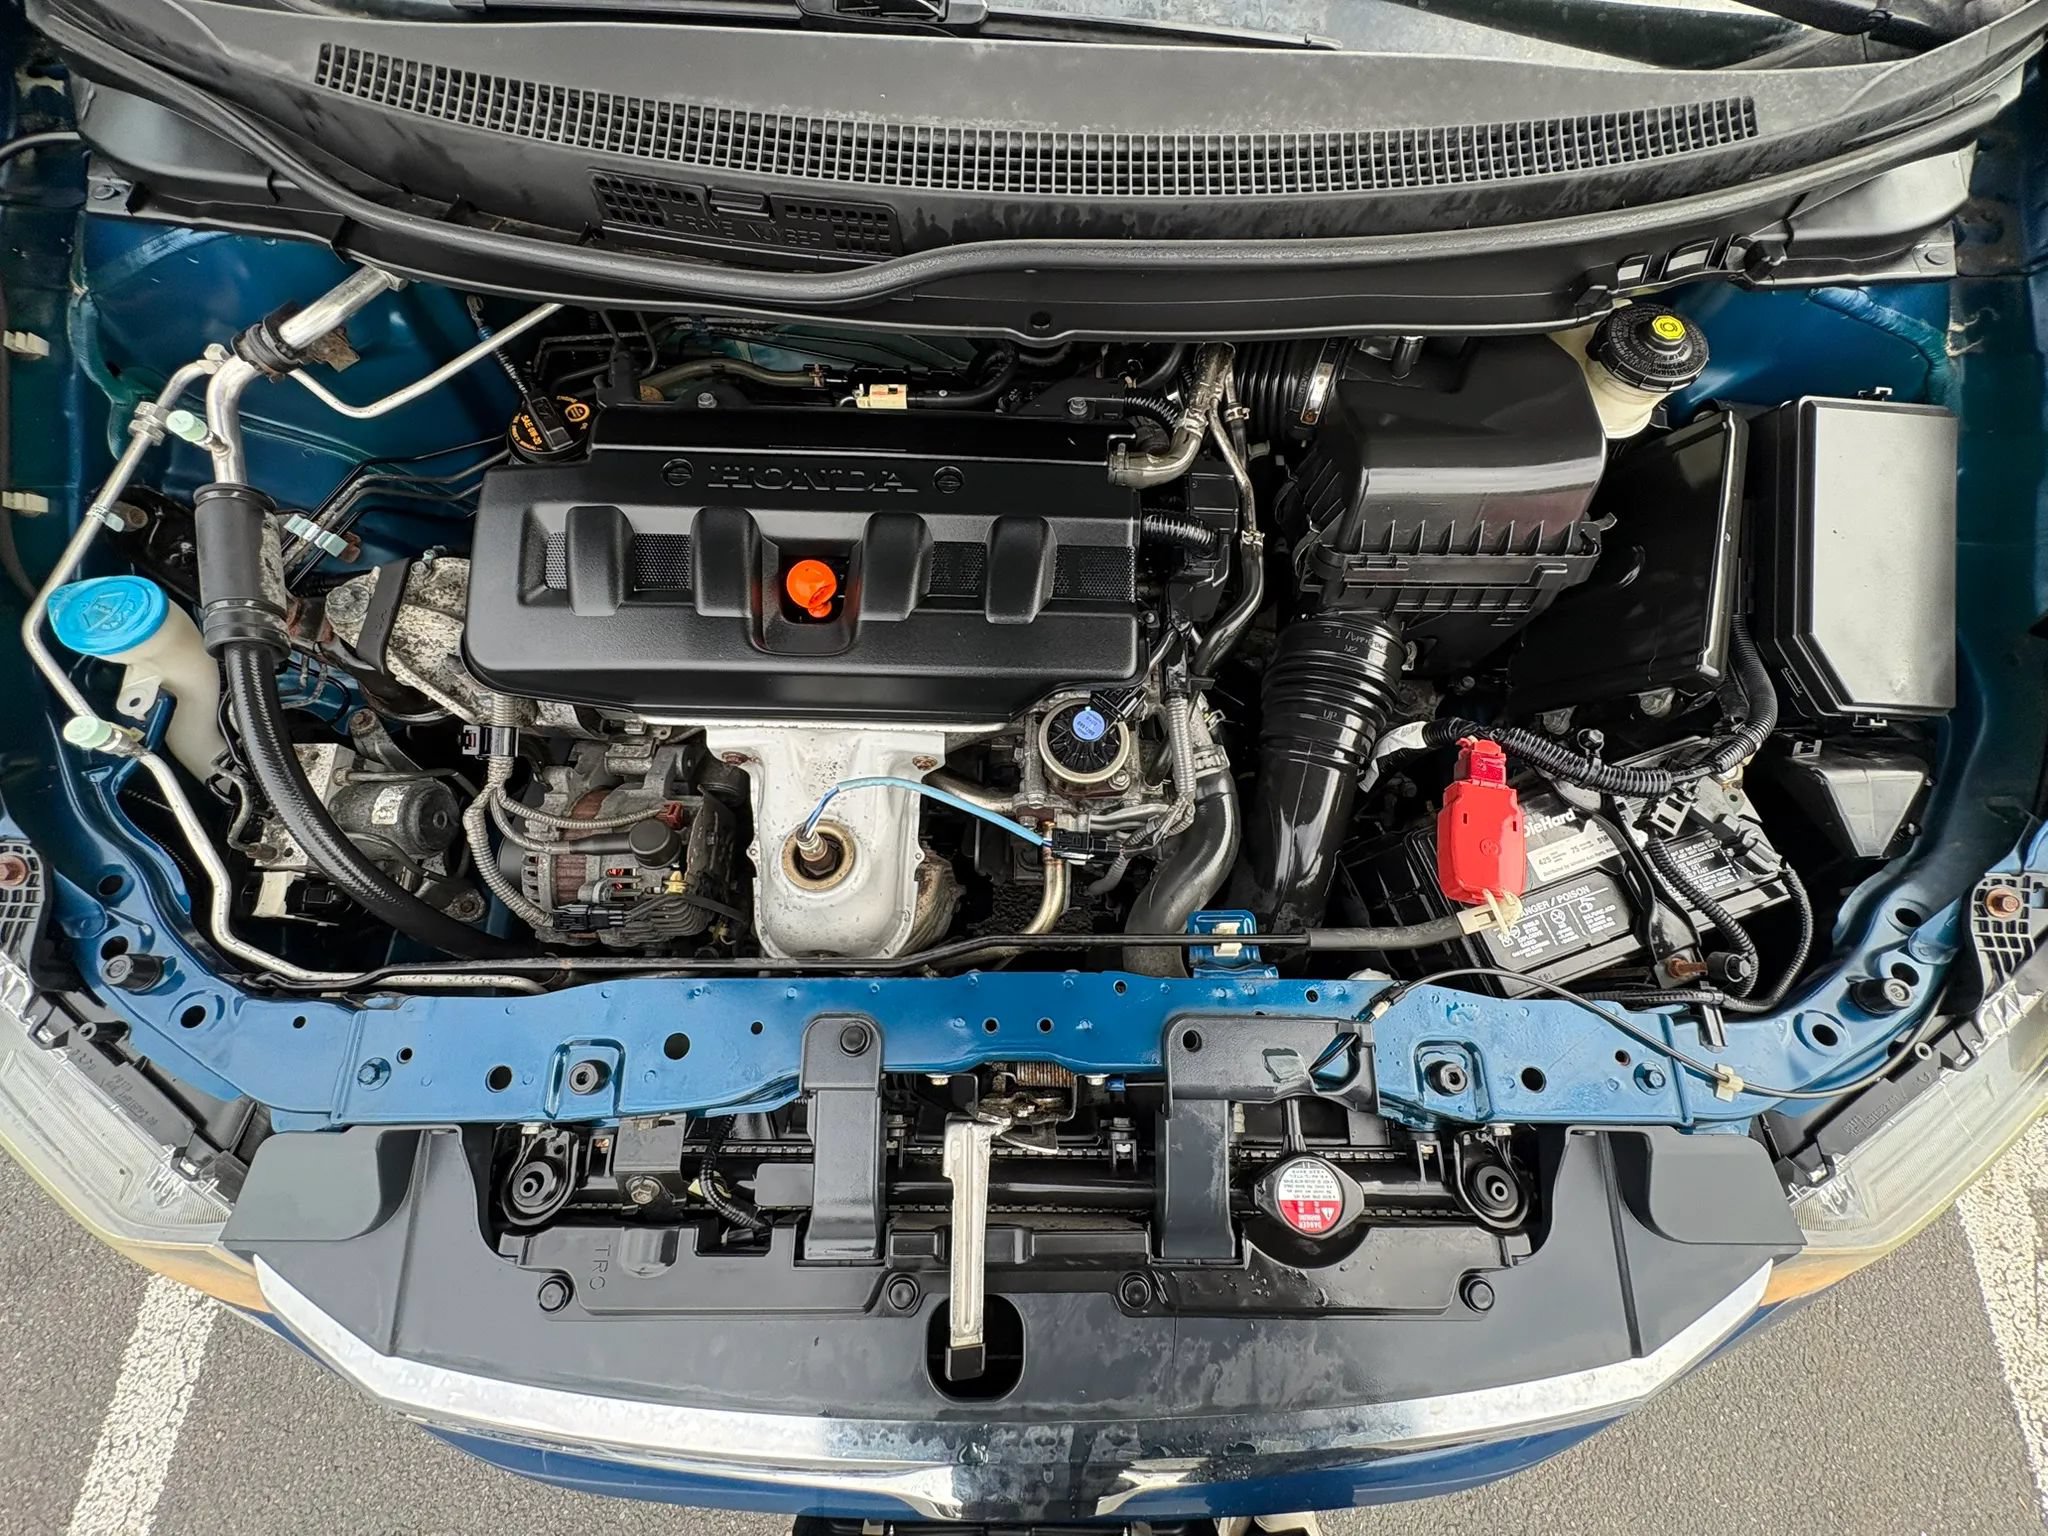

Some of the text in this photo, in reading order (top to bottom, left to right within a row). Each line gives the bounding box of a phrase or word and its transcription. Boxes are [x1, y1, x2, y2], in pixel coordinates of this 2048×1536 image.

[672, 213, 822, 245] FRAME NUMBER
[707, 466, 919, 492] HONDA
[1556, 885, 1590, 903] POISON
[589, 1244, 611, 1290] TRO
